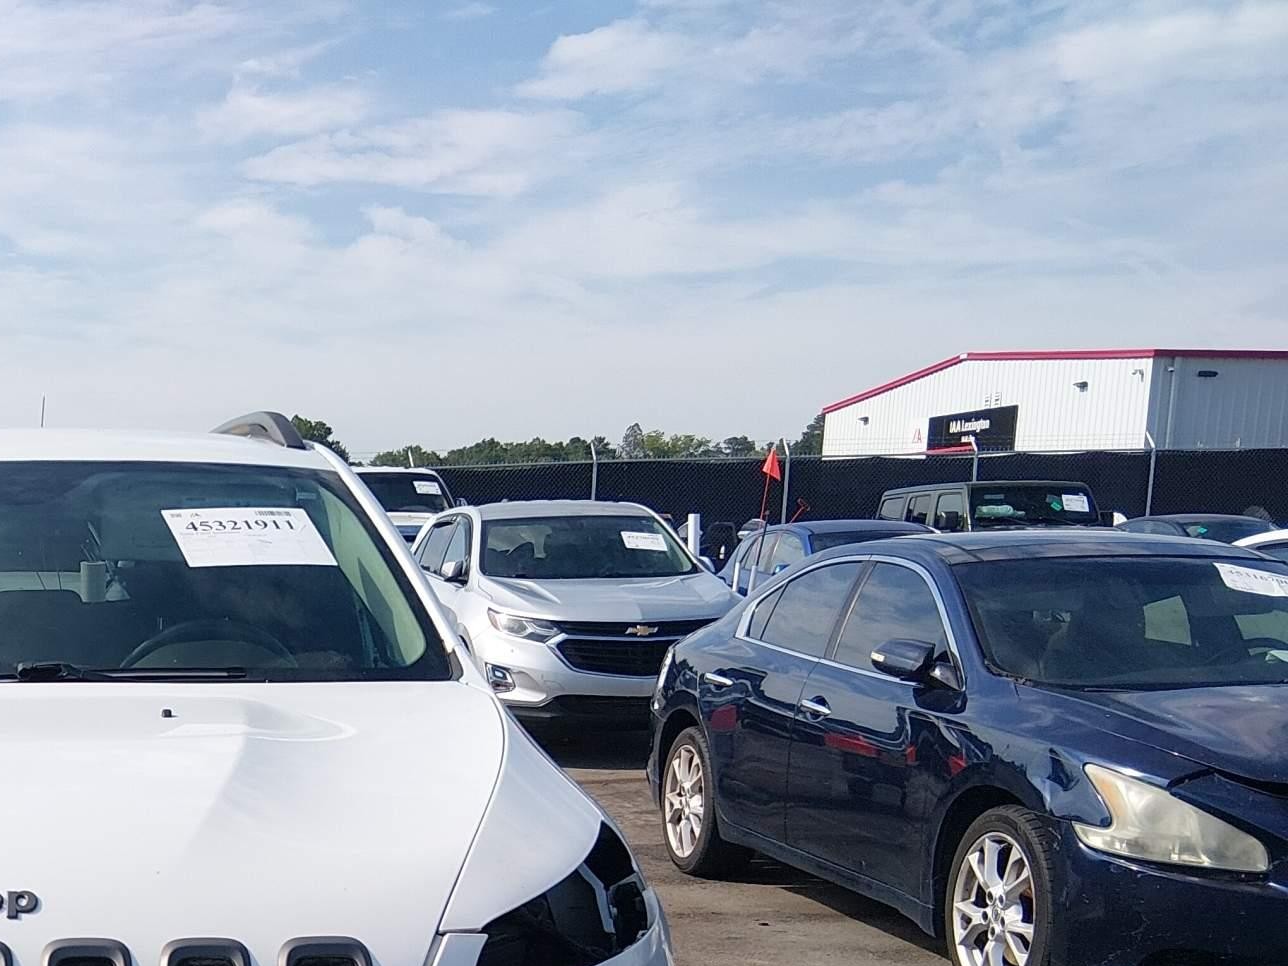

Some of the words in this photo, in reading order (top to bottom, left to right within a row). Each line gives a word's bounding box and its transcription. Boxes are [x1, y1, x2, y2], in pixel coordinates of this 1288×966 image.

[949, 420, 961, 433] IAA
[962, 418, 990, 433] Lexington
[185, 519, 295, 532] 45321911
